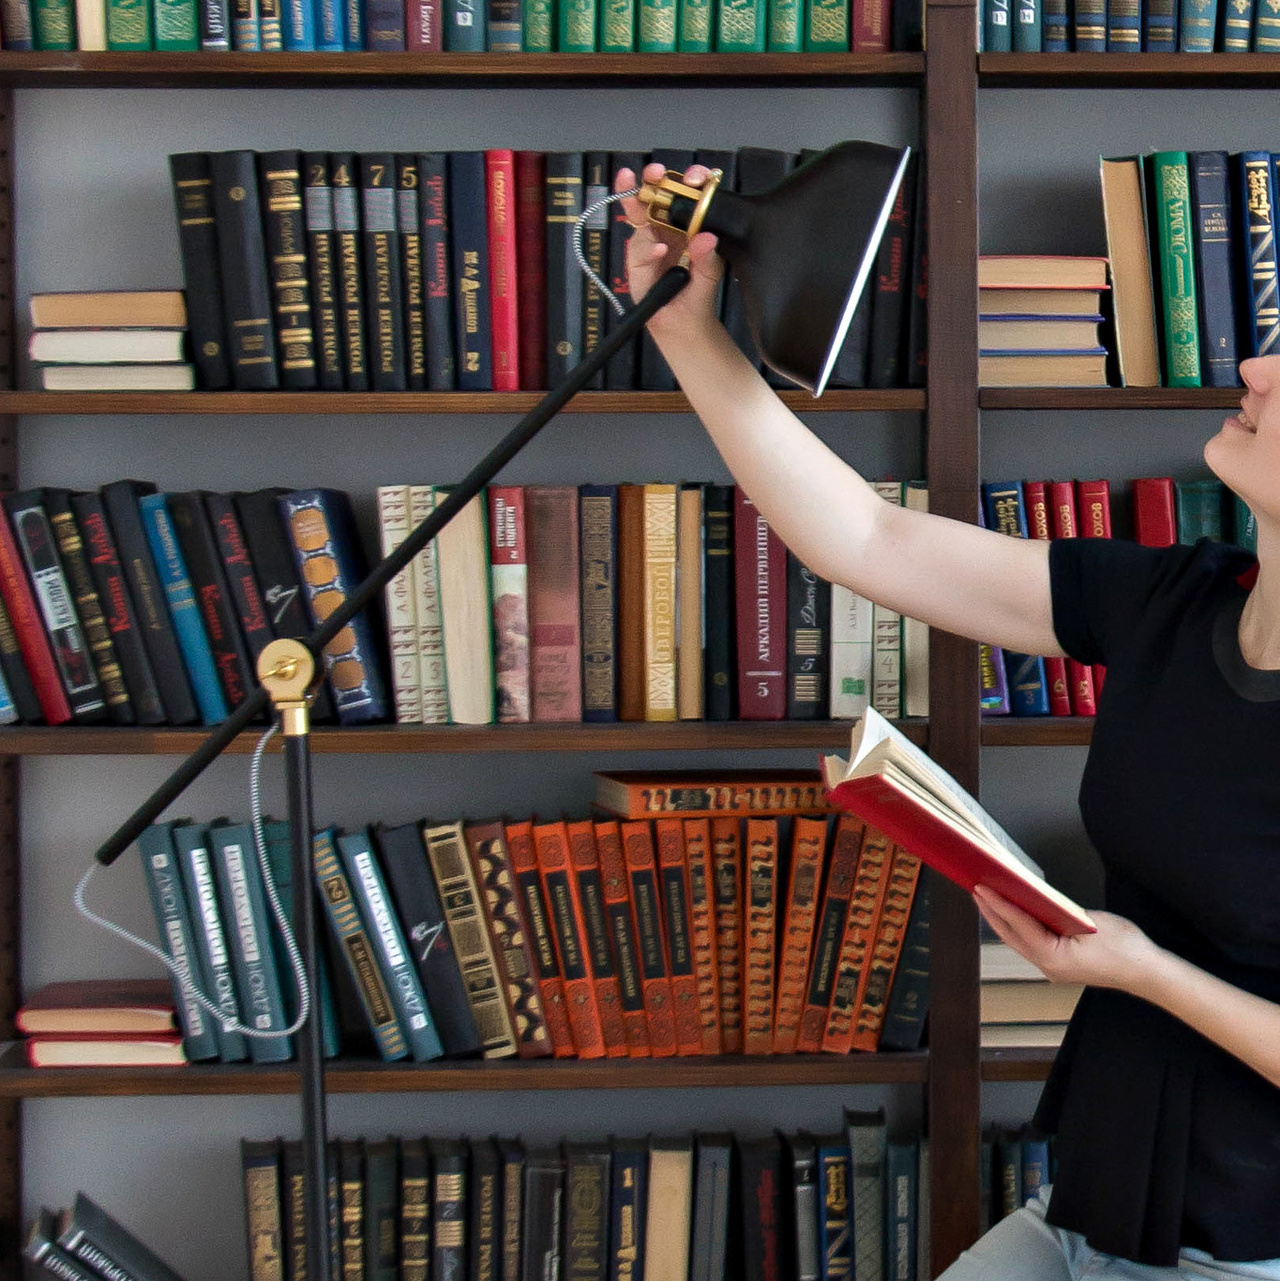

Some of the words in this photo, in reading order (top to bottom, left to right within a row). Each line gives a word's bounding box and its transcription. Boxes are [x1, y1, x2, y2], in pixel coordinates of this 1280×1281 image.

[310, 164, 326, 186] 2
[334, 164, 350, 186] 4
[370, 165, 384, 185] 7
[402, 166, 417, 188] 5
[1169, 200, 1187, 255] ДЮМА
[315, 233, 332, 302] РОЛЛАН
[342, 233, 359, 303] РОЛЛАН
[375, 233, 390, 302] РОЛЛАН
[406, 235, 422, 305] РОЛЛАН
[321, 308, 338, 371] РОМЕН
[347, 309, 362, 373] РОМЕН
[378, 309, 393, 373] РОМЕН
[409, 310, 424, 375] РОМЕН
[757, 597, 771, 662] АРКАДИЙ
